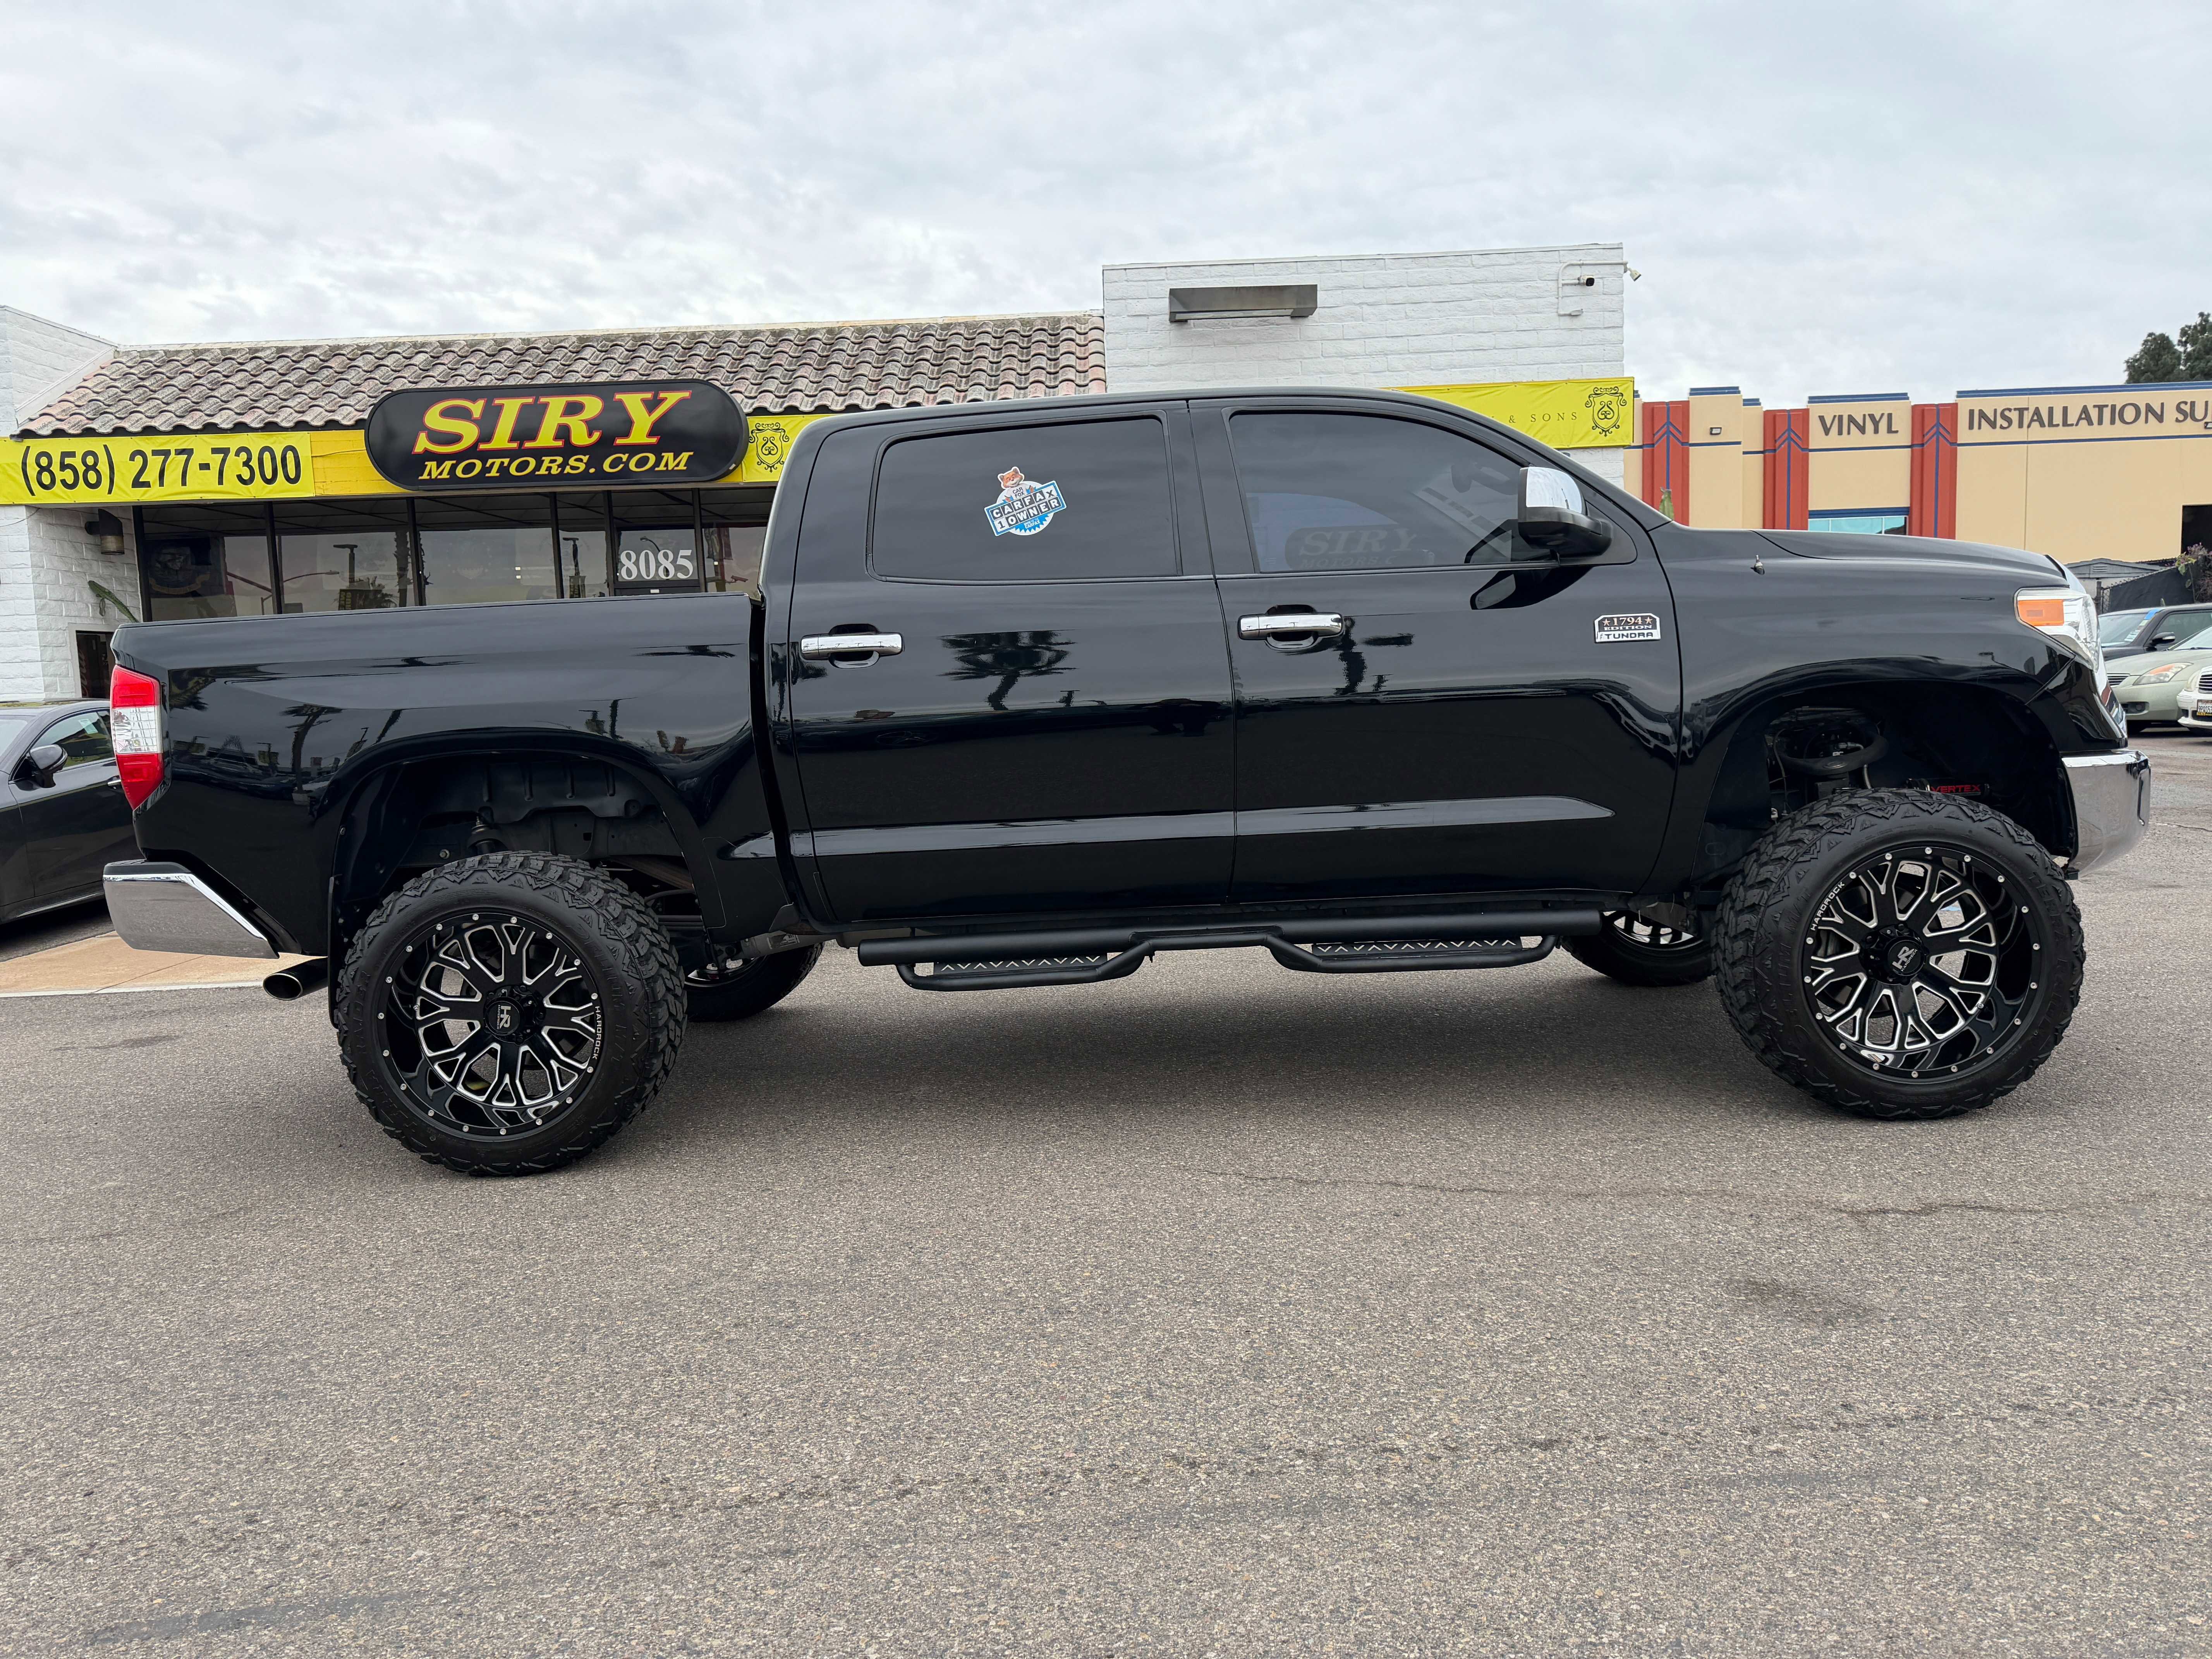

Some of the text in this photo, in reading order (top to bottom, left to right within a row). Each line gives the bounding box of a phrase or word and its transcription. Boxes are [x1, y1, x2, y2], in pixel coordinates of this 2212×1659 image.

[412, 390, 692, 455] SIRY
[1508, 412, 1577, 424] & SONS
[1818, 400, 2212, 436] VINYL INSTALLATION SU
[21, 444, 301, 496] (858) 277-7300
[418, 451, 694, 480] MOTORS.COM
[993, 489, 1055, 517] CARFAX
[998, 520, 1006, 529] 1
[1008, 499, 1059, 525] OWNER
[1300, 528, 1417, 555] SIRY
[619, 549, 694, 580] 8085
[1613, 617, 1643, 625] 1794
[1930, 785, 1980, 793] VERTEX
[1810, 881, 1845, 931] HARDROCK
[1892, 946, 1915, 970] HR
[1901, 949, 1918, 972] HARDROCK
[592, 1006, 602, 1060] HARDROCK
